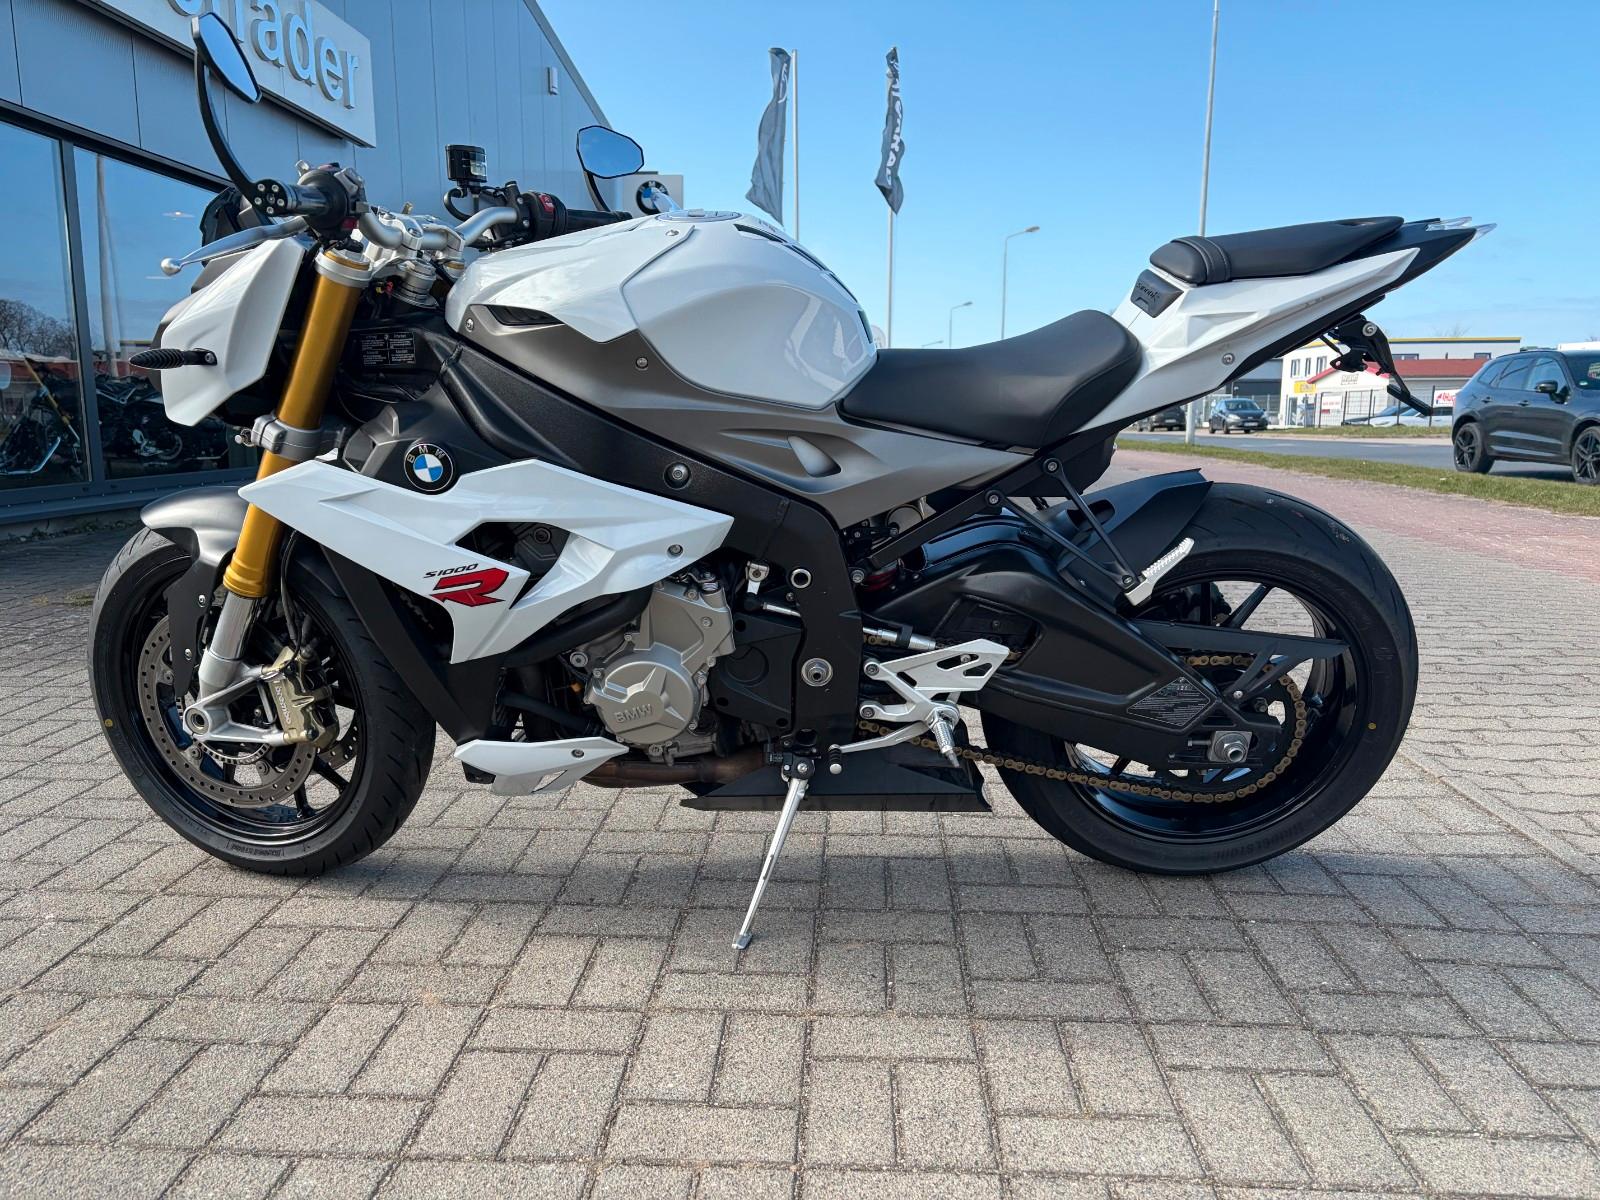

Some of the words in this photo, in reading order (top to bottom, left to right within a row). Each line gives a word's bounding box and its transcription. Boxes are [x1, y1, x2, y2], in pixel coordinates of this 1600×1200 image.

[406, 445, 447, 464] BMW
[275, 686, 292, 725] brembo
[614, 703, 654, 723] BMW
